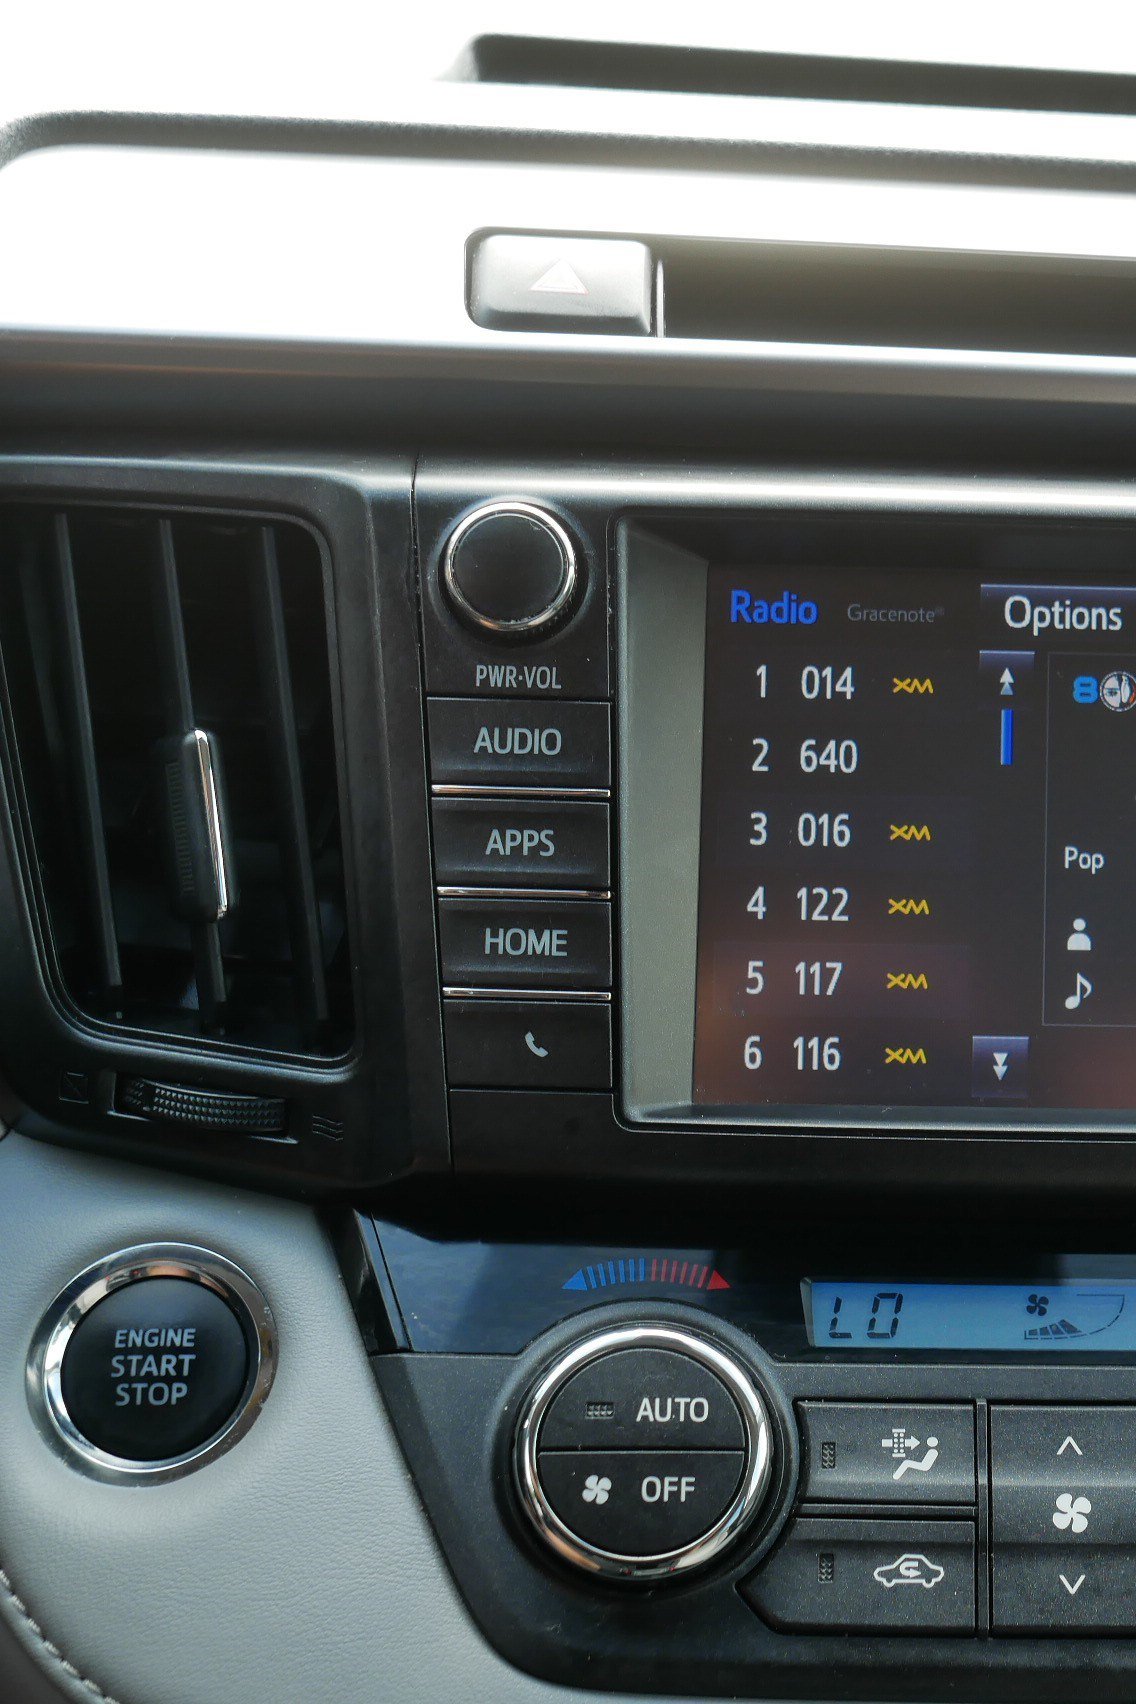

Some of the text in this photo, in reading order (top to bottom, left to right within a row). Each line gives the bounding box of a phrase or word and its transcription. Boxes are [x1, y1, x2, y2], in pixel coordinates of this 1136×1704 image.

[730, 589, 819, 625] Radio
[1003, 595, 1123, 636] Options
[756, 664, 768, 699] 1
[800, 665, 856, 700] 014
[473, 726, 562, 757] AUDIO
[751, 738, 859, 774] 2 640
[485, 829, 555, 857] APPS
[749, 812, 768, 847] 3
[797, 813, 852, 848] 016
[1064, 846, 1105, 875] Pop
[746, 886, 767, 920] 4
[796, 886, 850, 921] 122
[484, 927, 568, 957] HOME
[746, 960, 765, 995] 5
[795, 961, 843, 996] 117
[743, 1035, 763, 1070] 6
[793, 1036, 841, 1071] 116
[113, 1328, 197, 1349] ENGINE
[110, 1354, 197, 1378] START
[114, 1383, 189, 1406] STOP
[636, 1397, 710, 1423] AUTO
[640, 1476, 697, 1502] OFF
